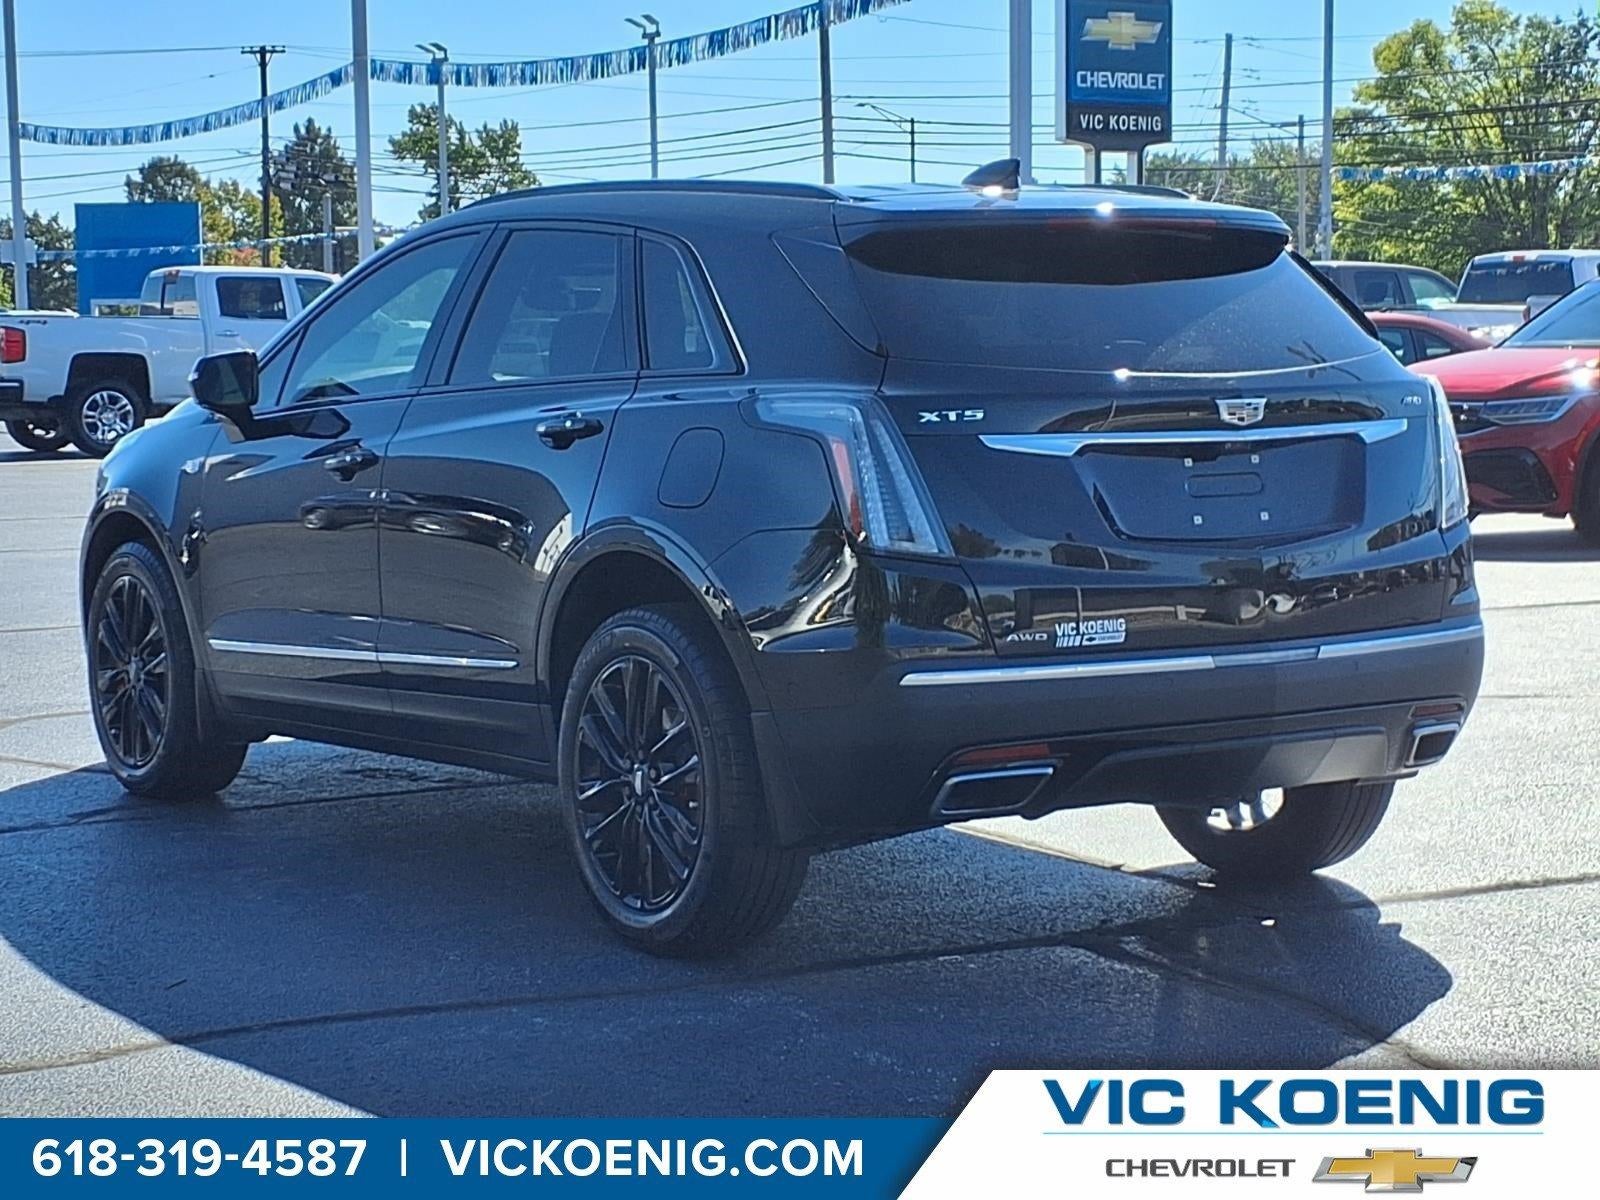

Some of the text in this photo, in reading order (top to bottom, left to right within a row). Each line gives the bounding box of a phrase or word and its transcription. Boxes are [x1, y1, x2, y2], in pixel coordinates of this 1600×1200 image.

[1076, 71, 1165, 90] CHEVROLET
[1080, 114, 1162, 131] VIC KOENIG
[918, 409, 984, 423] XT5
[1055, 618, 1126, 636] VIC KOENIG
[1006, 632, 1048, 642] AWD
